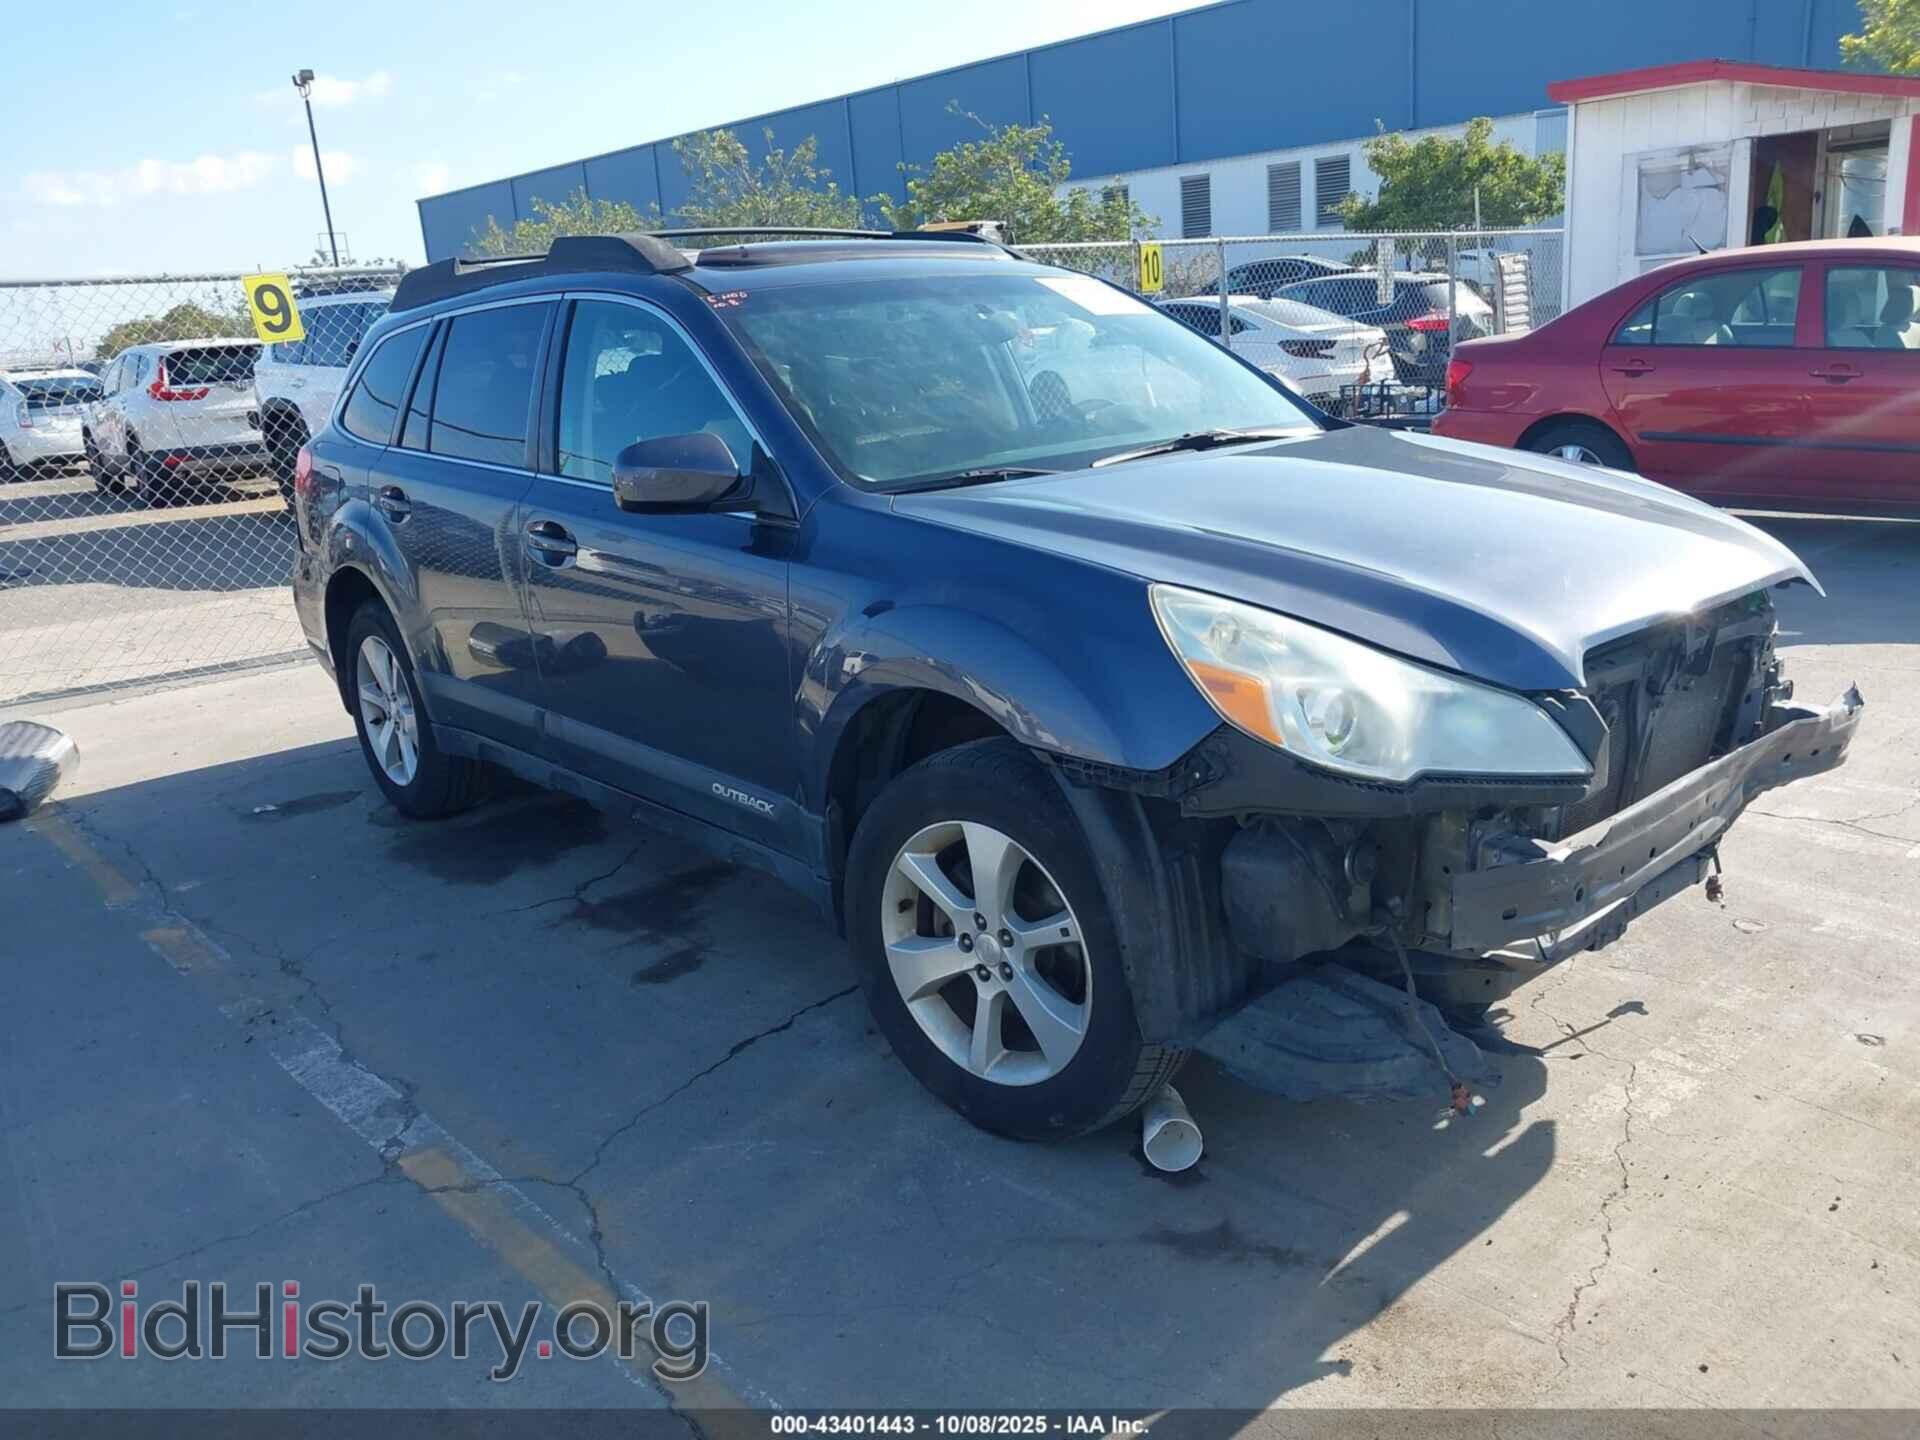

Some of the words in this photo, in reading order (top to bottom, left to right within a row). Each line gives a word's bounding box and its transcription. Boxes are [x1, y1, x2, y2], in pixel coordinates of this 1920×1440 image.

[1143, 250, 1160, 285] 10
[254, 283, 292, 334] 9
[711, 782, 775, 816] OUTBACK
